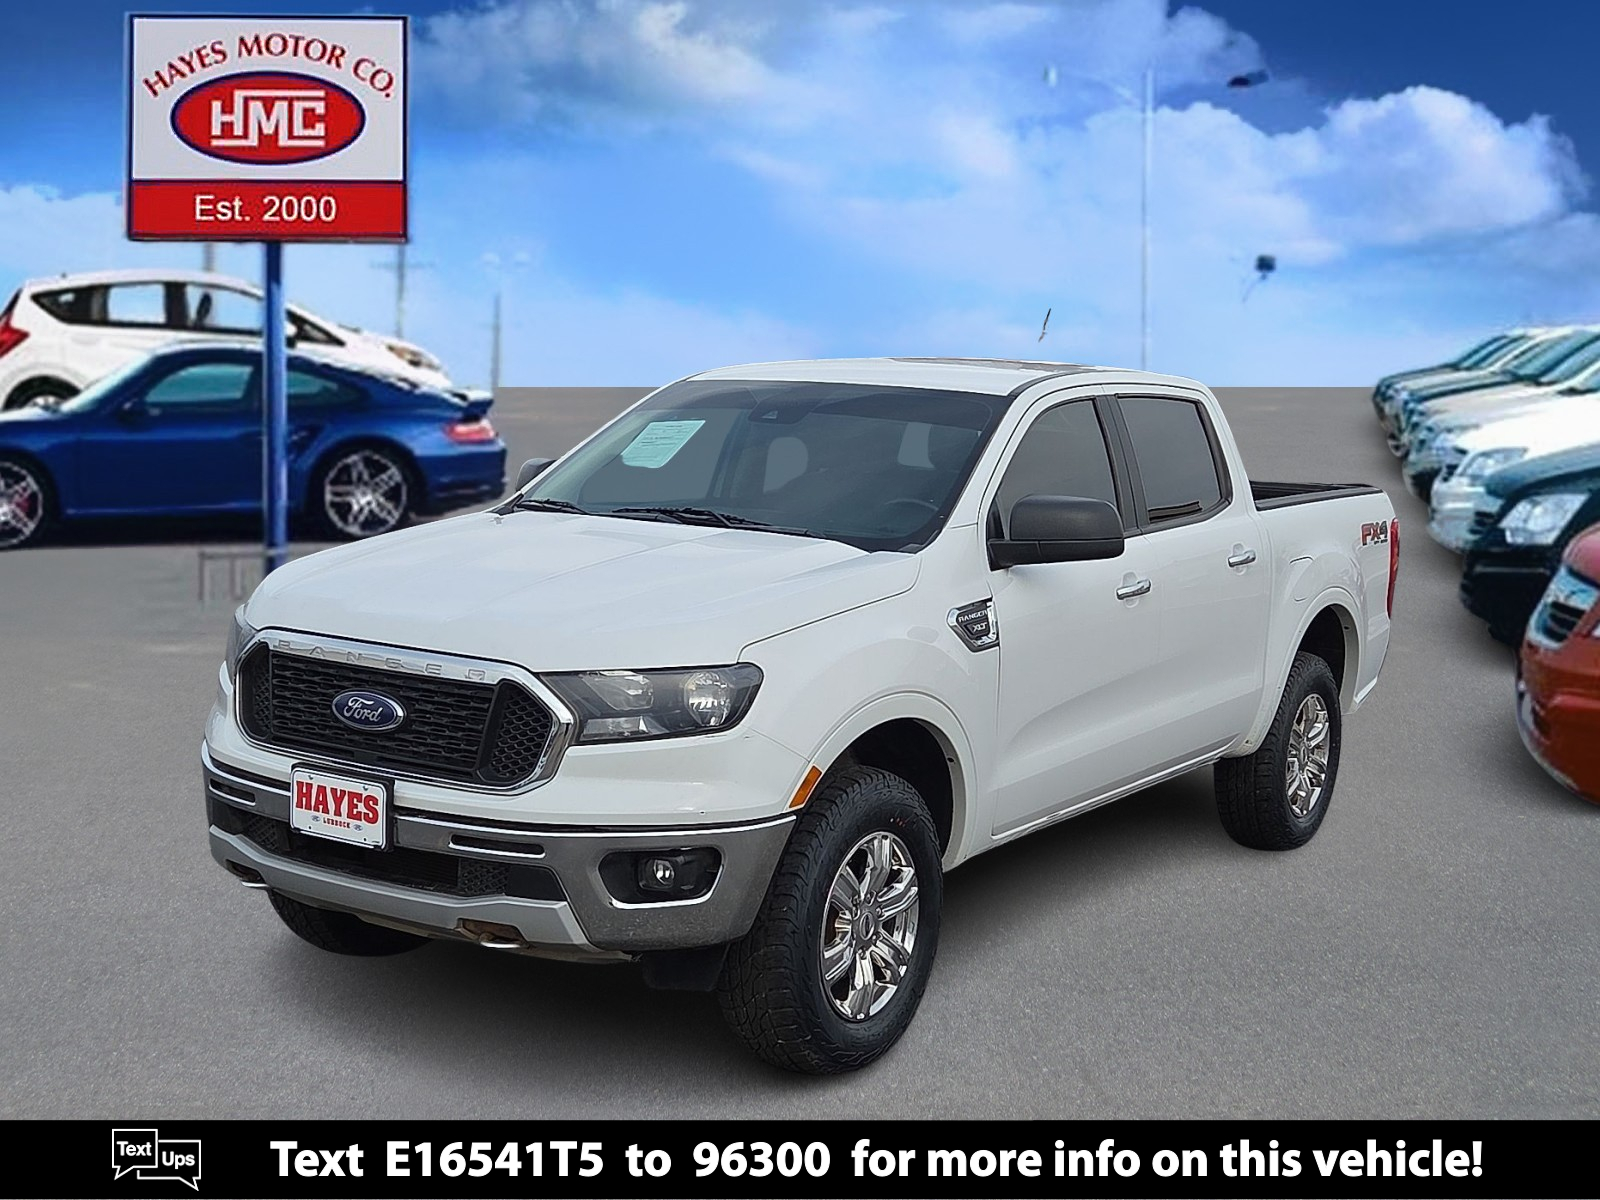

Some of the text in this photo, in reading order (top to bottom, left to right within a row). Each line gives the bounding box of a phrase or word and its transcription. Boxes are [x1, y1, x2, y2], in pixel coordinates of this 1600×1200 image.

[143, 33, 395, 98] HAYES MOTOR CO.
[210, 89, 326, 147] HMC
[195, 195, 337, 222] Est. 2000
[1361, 520, 1388, 546] FX4
[343, 696, 382, 722] Ford
[295, 780, 379, 825] HAYES
